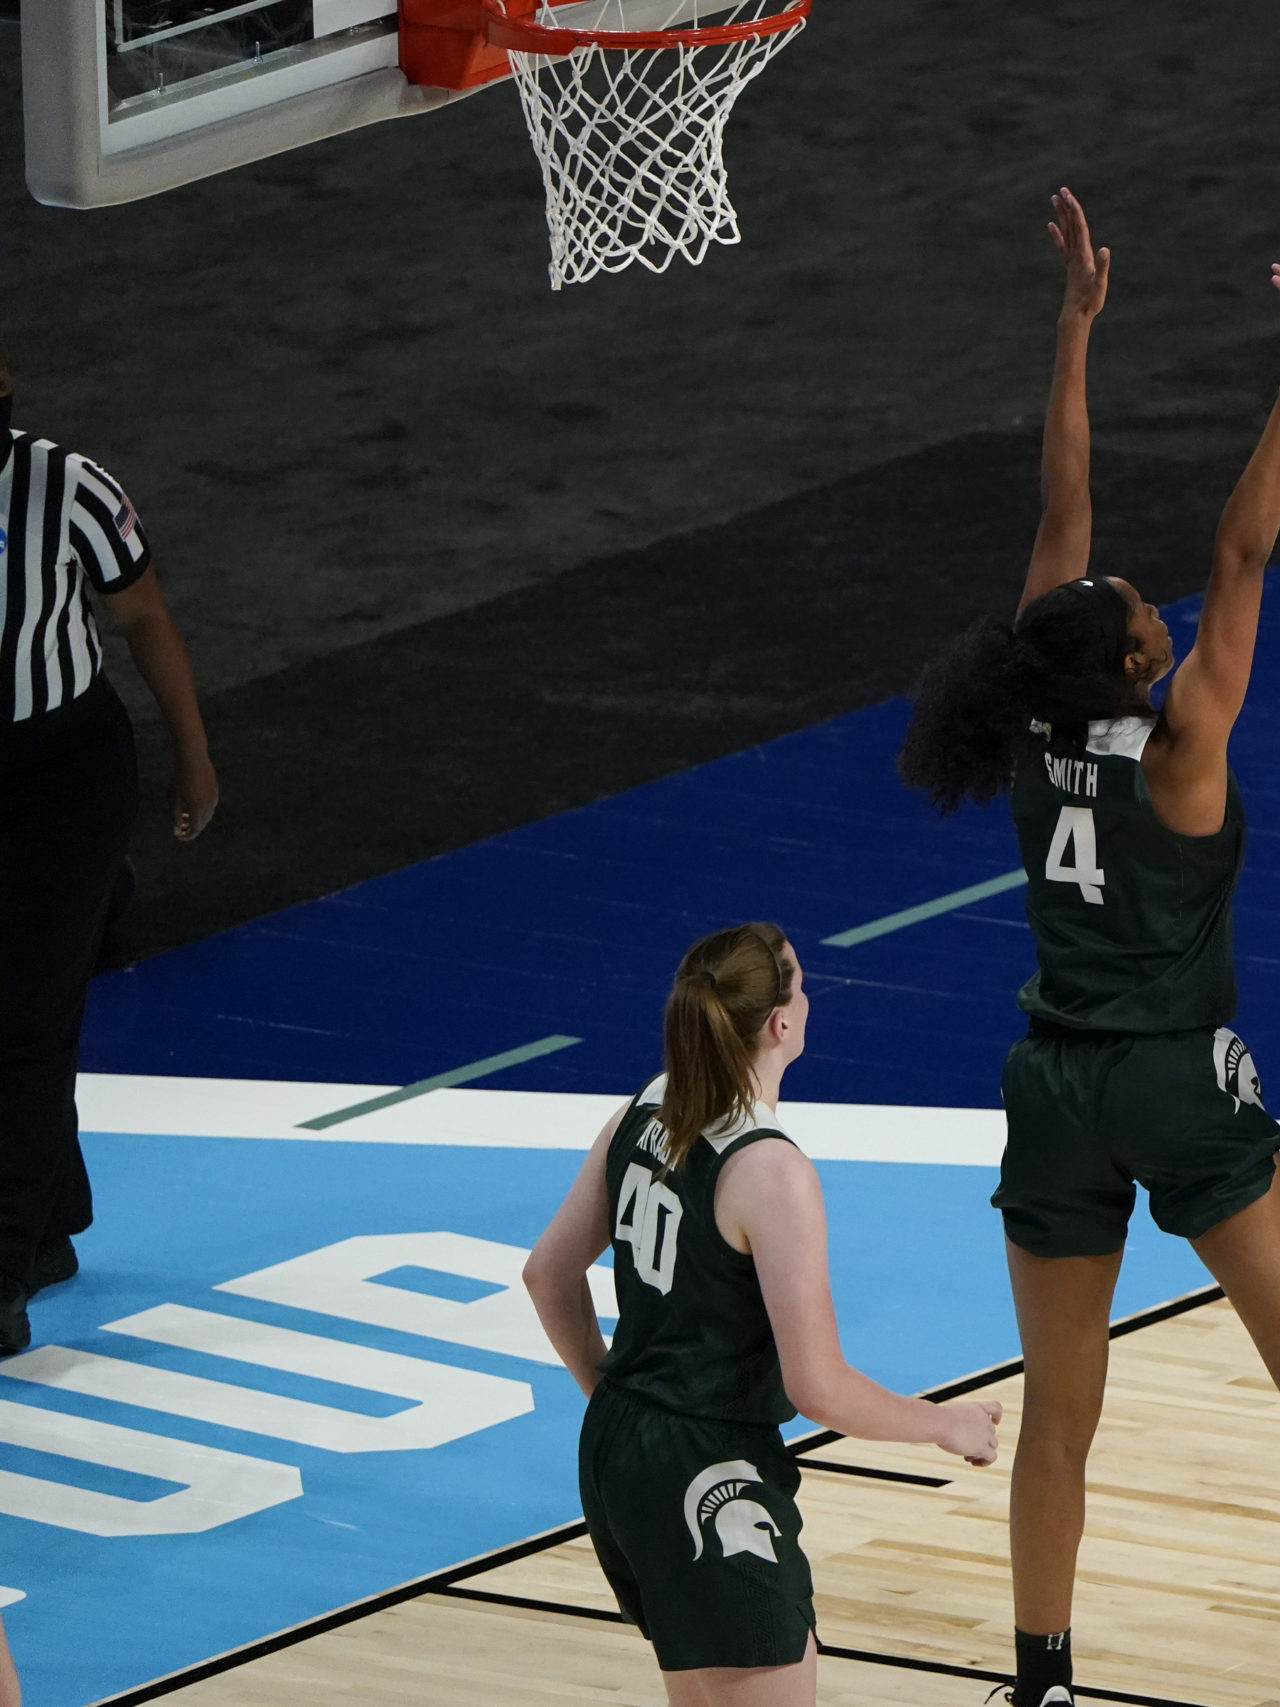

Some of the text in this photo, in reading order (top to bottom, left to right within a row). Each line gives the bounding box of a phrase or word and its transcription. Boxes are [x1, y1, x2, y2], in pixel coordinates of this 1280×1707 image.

[1045, 752, 1098, 798] SMITH
[1045, 805, 1106, 905] 4
[615, 1161, 684, 1297] 40
